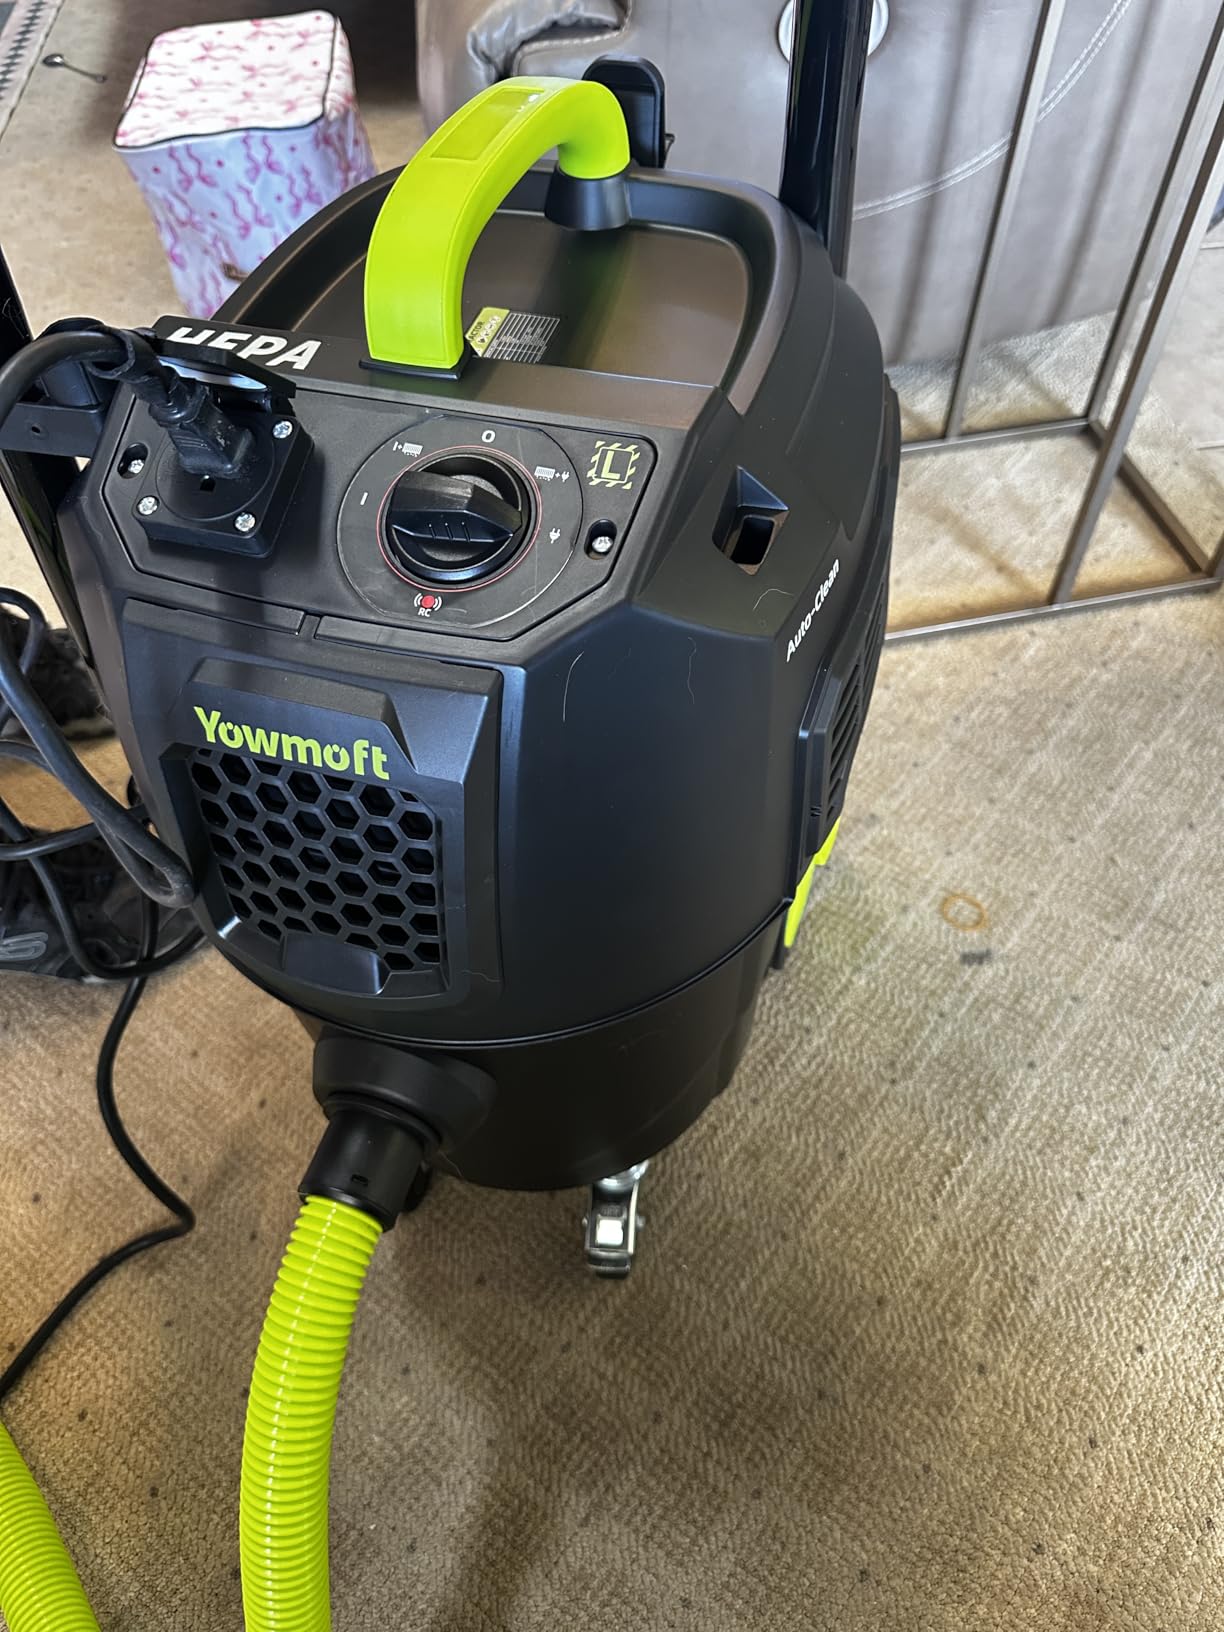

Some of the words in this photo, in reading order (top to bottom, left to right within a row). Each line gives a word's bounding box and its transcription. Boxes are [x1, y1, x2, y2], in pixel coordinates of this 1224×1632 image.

[601, 450, 621, 480] L
[418, 607, 432, 617] RC
[786, 559, 840, 662] Auto-Clean
